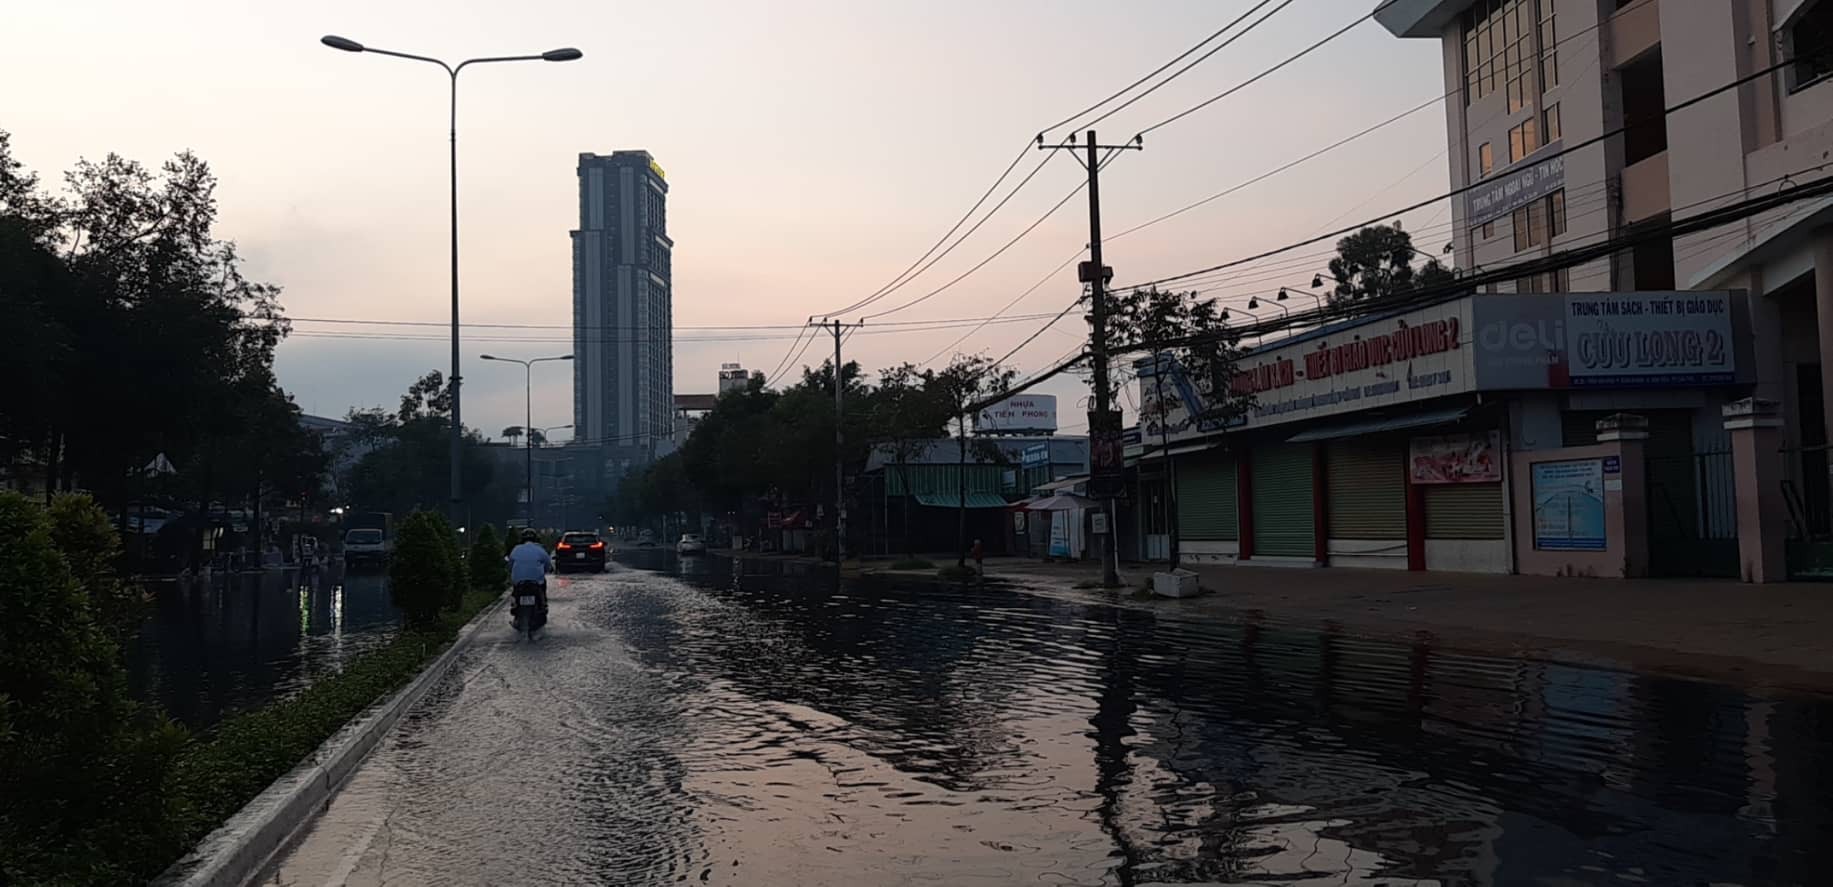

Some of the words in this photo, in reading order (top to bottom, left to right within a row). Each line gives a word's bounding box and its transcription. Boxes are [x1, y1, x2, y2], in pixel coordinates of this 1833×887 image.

[1571, 301, 1600, 316] TRUNG
[1600, 297, 1619, 316] TÂM
[1621, 297, 1643, 315] SÁCH
[1649, 296, 1674, 315] THIẾT
[1676, 300, 1685, 317] BỊ
[1686, 296, 1706, 314] GIÁO
[1707, 299, 1724, 316] DỤC
[1447, 316, 1460, 349] 2
[1480, 320, 1563, 352] deli
[1577, 319, 1631, 369] CỬU
[1633, 329, 1704, 368] LONG
[1706, 328, 1726, 367] 2
